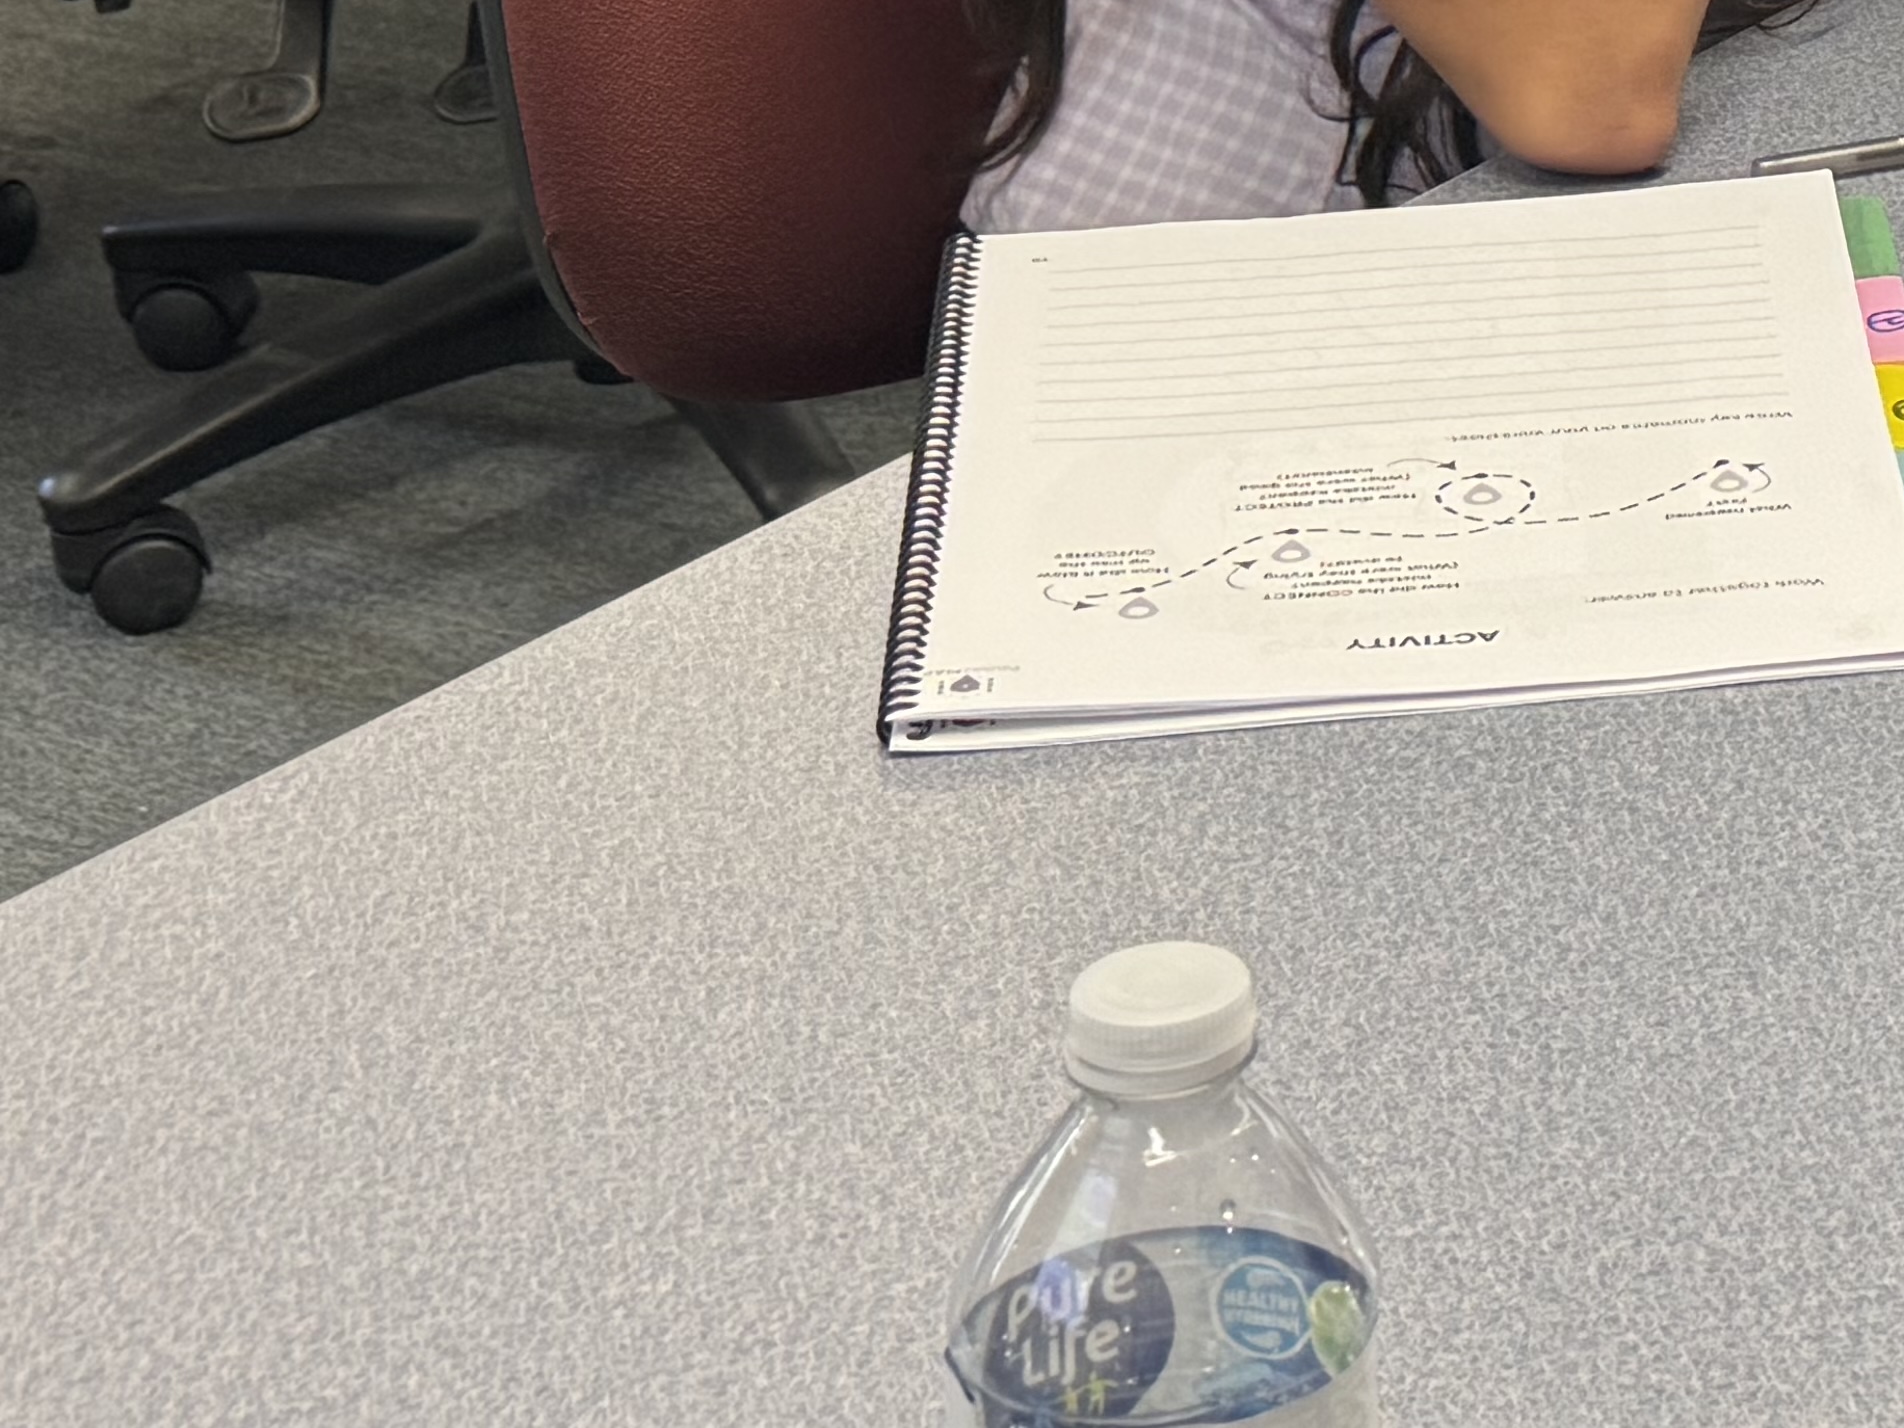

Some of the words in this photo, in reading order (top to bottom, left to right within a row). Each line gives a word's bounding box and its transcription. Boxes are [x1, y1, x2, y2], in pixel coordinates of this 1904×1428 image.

[1346, 630, 1499, 650] ACTIVITY
[1008, 1258, 1138, 1342] Pure
[1021, 1318, 1124, 1388] Life
